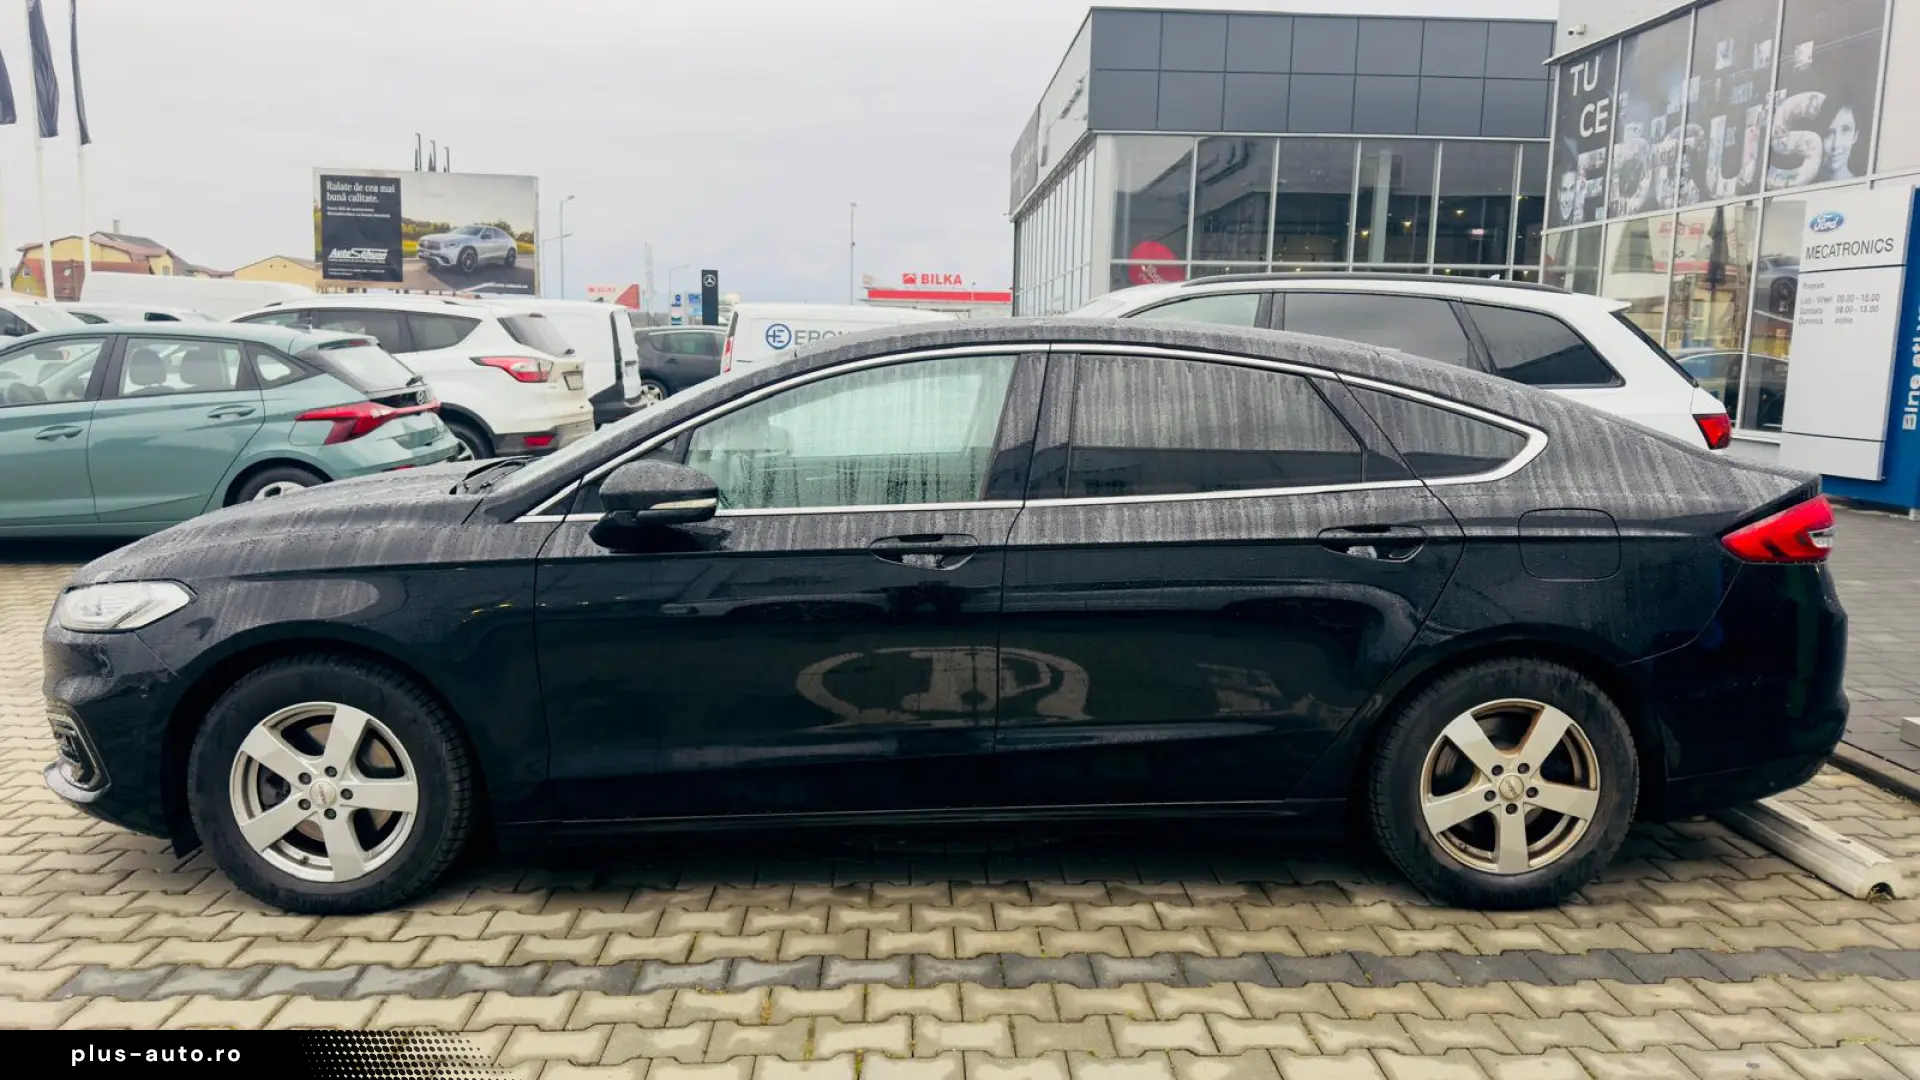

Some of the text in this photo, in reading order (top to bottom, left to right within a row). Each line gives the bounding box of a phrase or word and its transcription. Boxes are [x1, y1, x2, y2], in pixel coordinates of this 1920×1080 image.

[1569, 55, 1600, 97] TU
[1579, 97, 1610, 139] CE
[353, 181, 364, 192] de
[364, 184, 379, 193] cea
[380, 184, 396, 193] mai
[1806, 236, 1895, 261] MECATRONICS
[920, 273, 962, 287] BILKA
